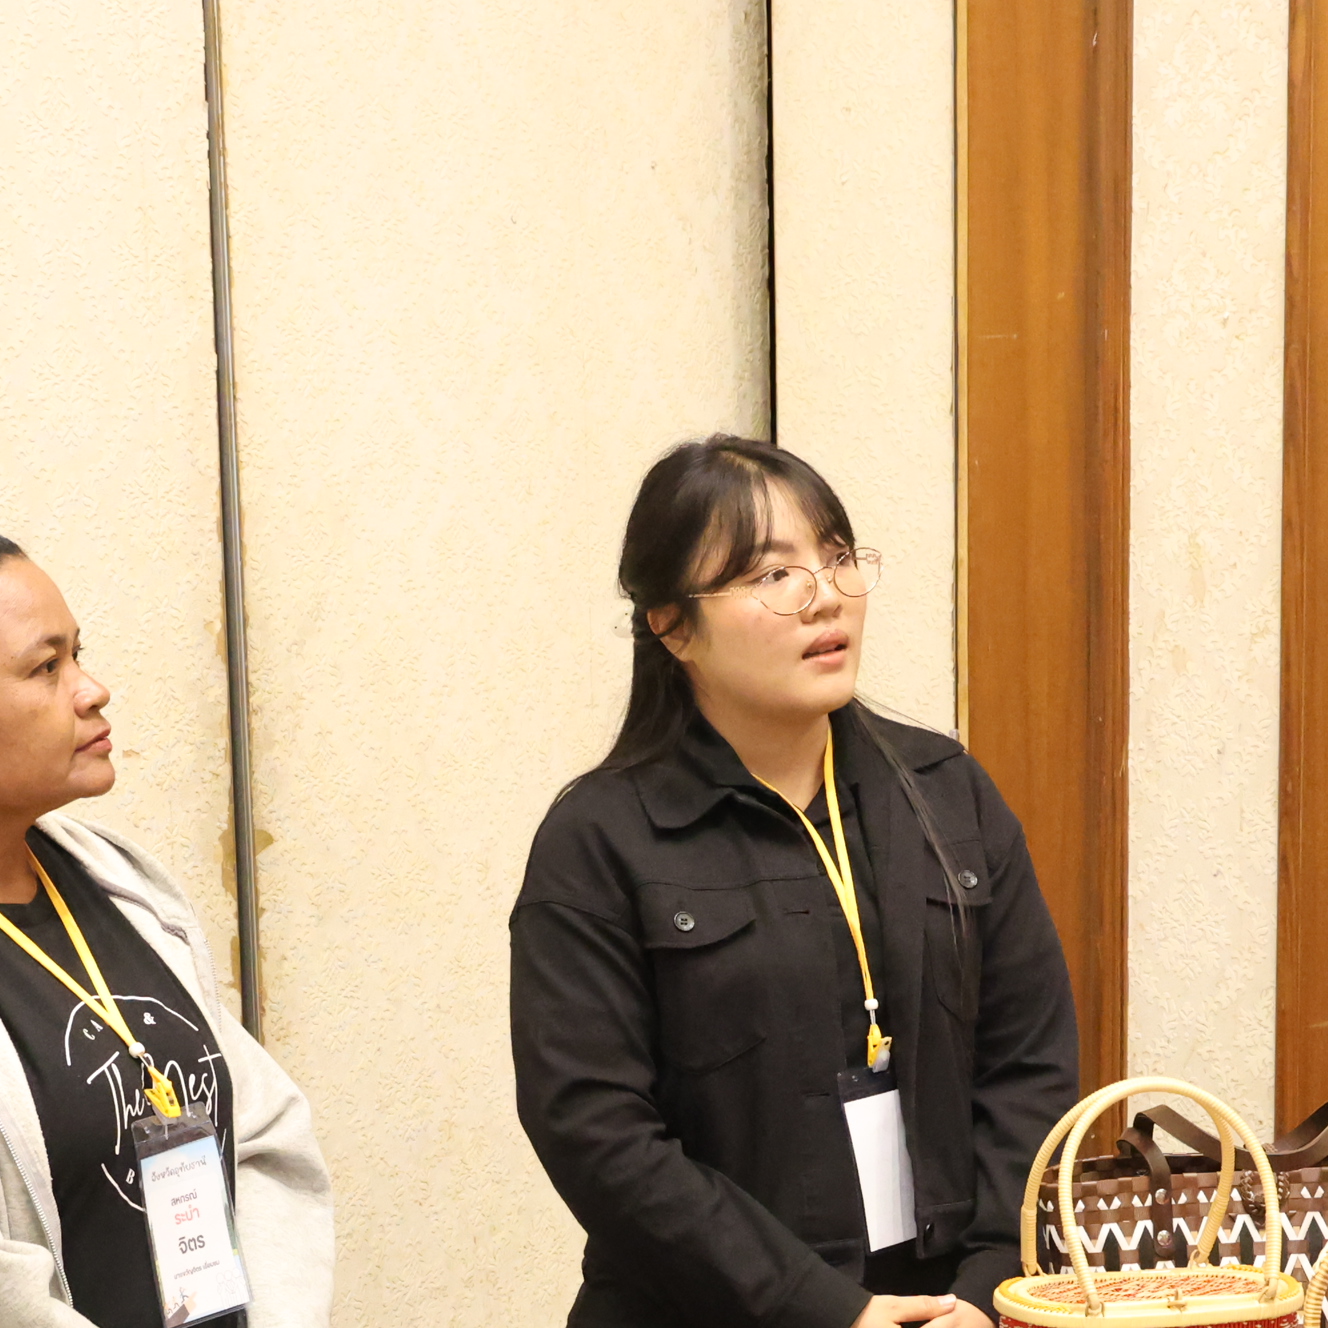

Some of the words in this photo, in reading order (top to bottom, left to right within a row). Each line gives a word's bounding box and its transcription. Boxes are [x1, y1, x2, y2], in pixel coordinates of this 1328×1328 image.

[170, 1188, 198, 1207] สหกรณ์
[174, 1204, 201, 1226] ระบำ
[178, 1234, 206, 1255] จิตร
